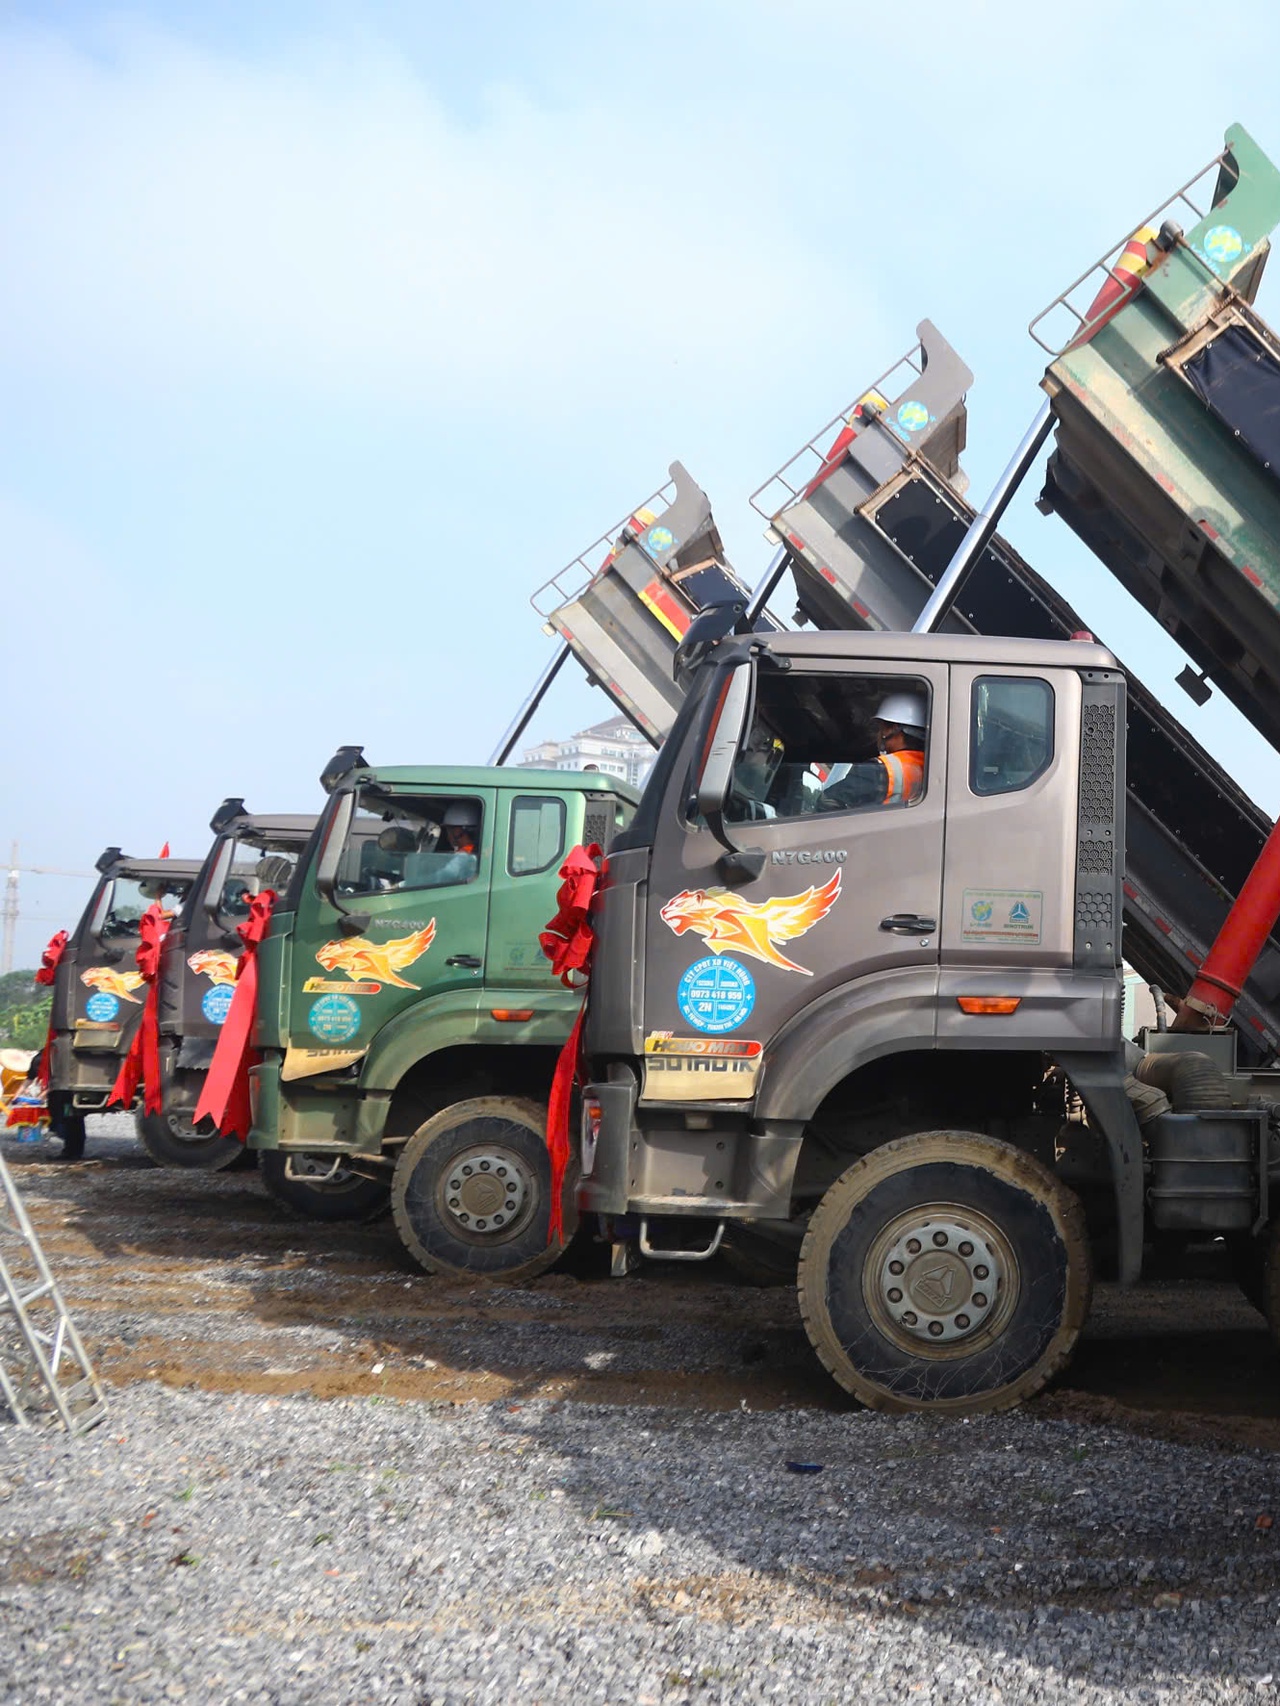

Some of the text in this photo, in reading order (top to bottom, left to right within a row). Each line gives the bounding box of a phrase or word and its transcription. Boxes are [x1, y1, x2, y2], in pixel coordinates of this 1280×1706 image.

[771, 850, 848, 866] N7G400
[690, 989, 710, 998] 0973
[698, 1002, 713, 1012] 2N
